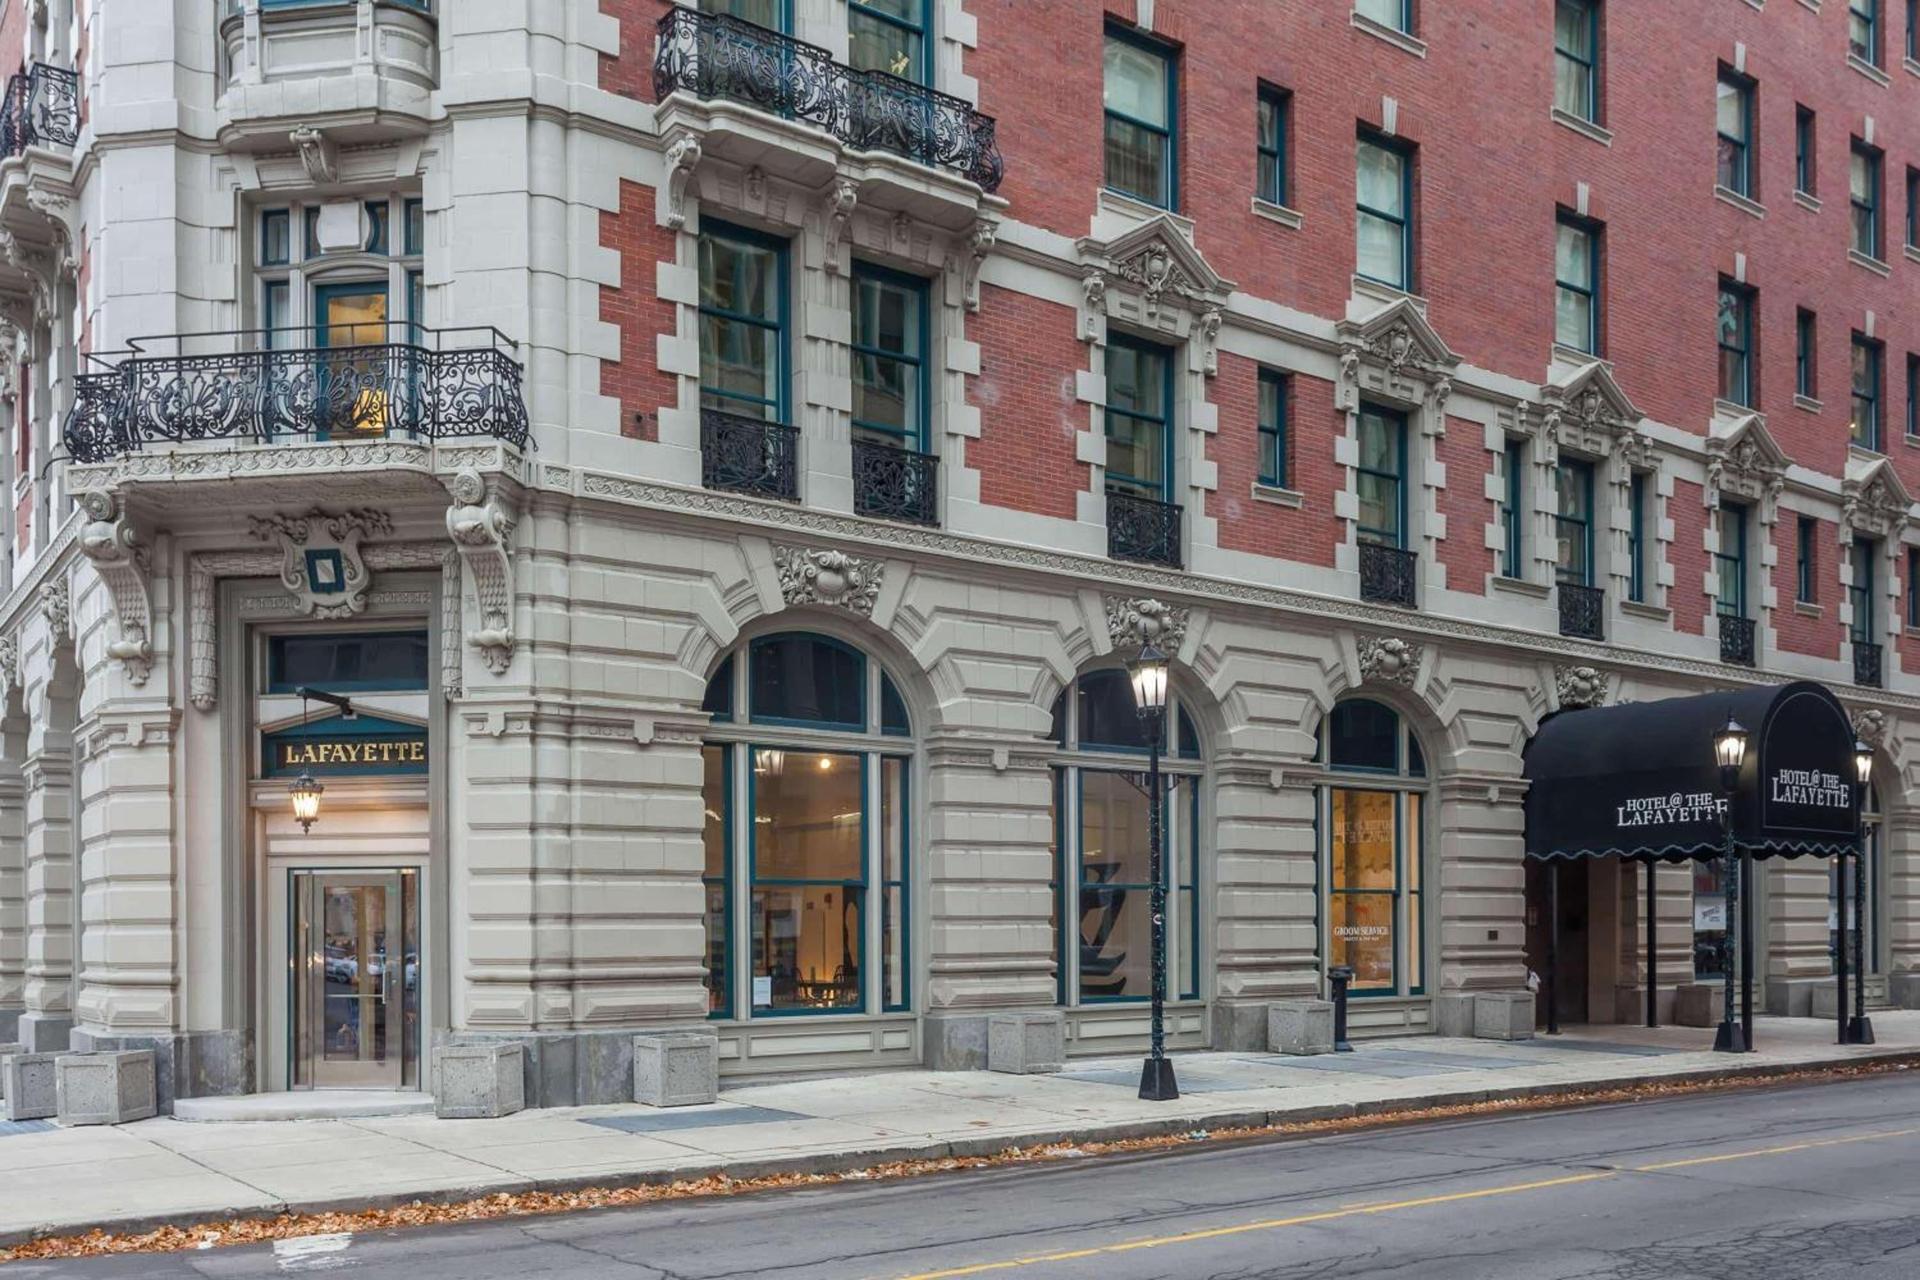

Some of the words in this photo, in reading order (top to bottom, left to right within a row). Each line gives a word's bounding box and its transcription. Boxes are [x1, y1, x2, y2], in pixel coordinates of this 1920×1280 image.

[285, 741, 425, 764] LAFAYETTE
[1821, 773, 1840, 789] THE
[1685, 792, 1713, 807] THE
[1772, 777, 1849, 808] LAFAYETTE
